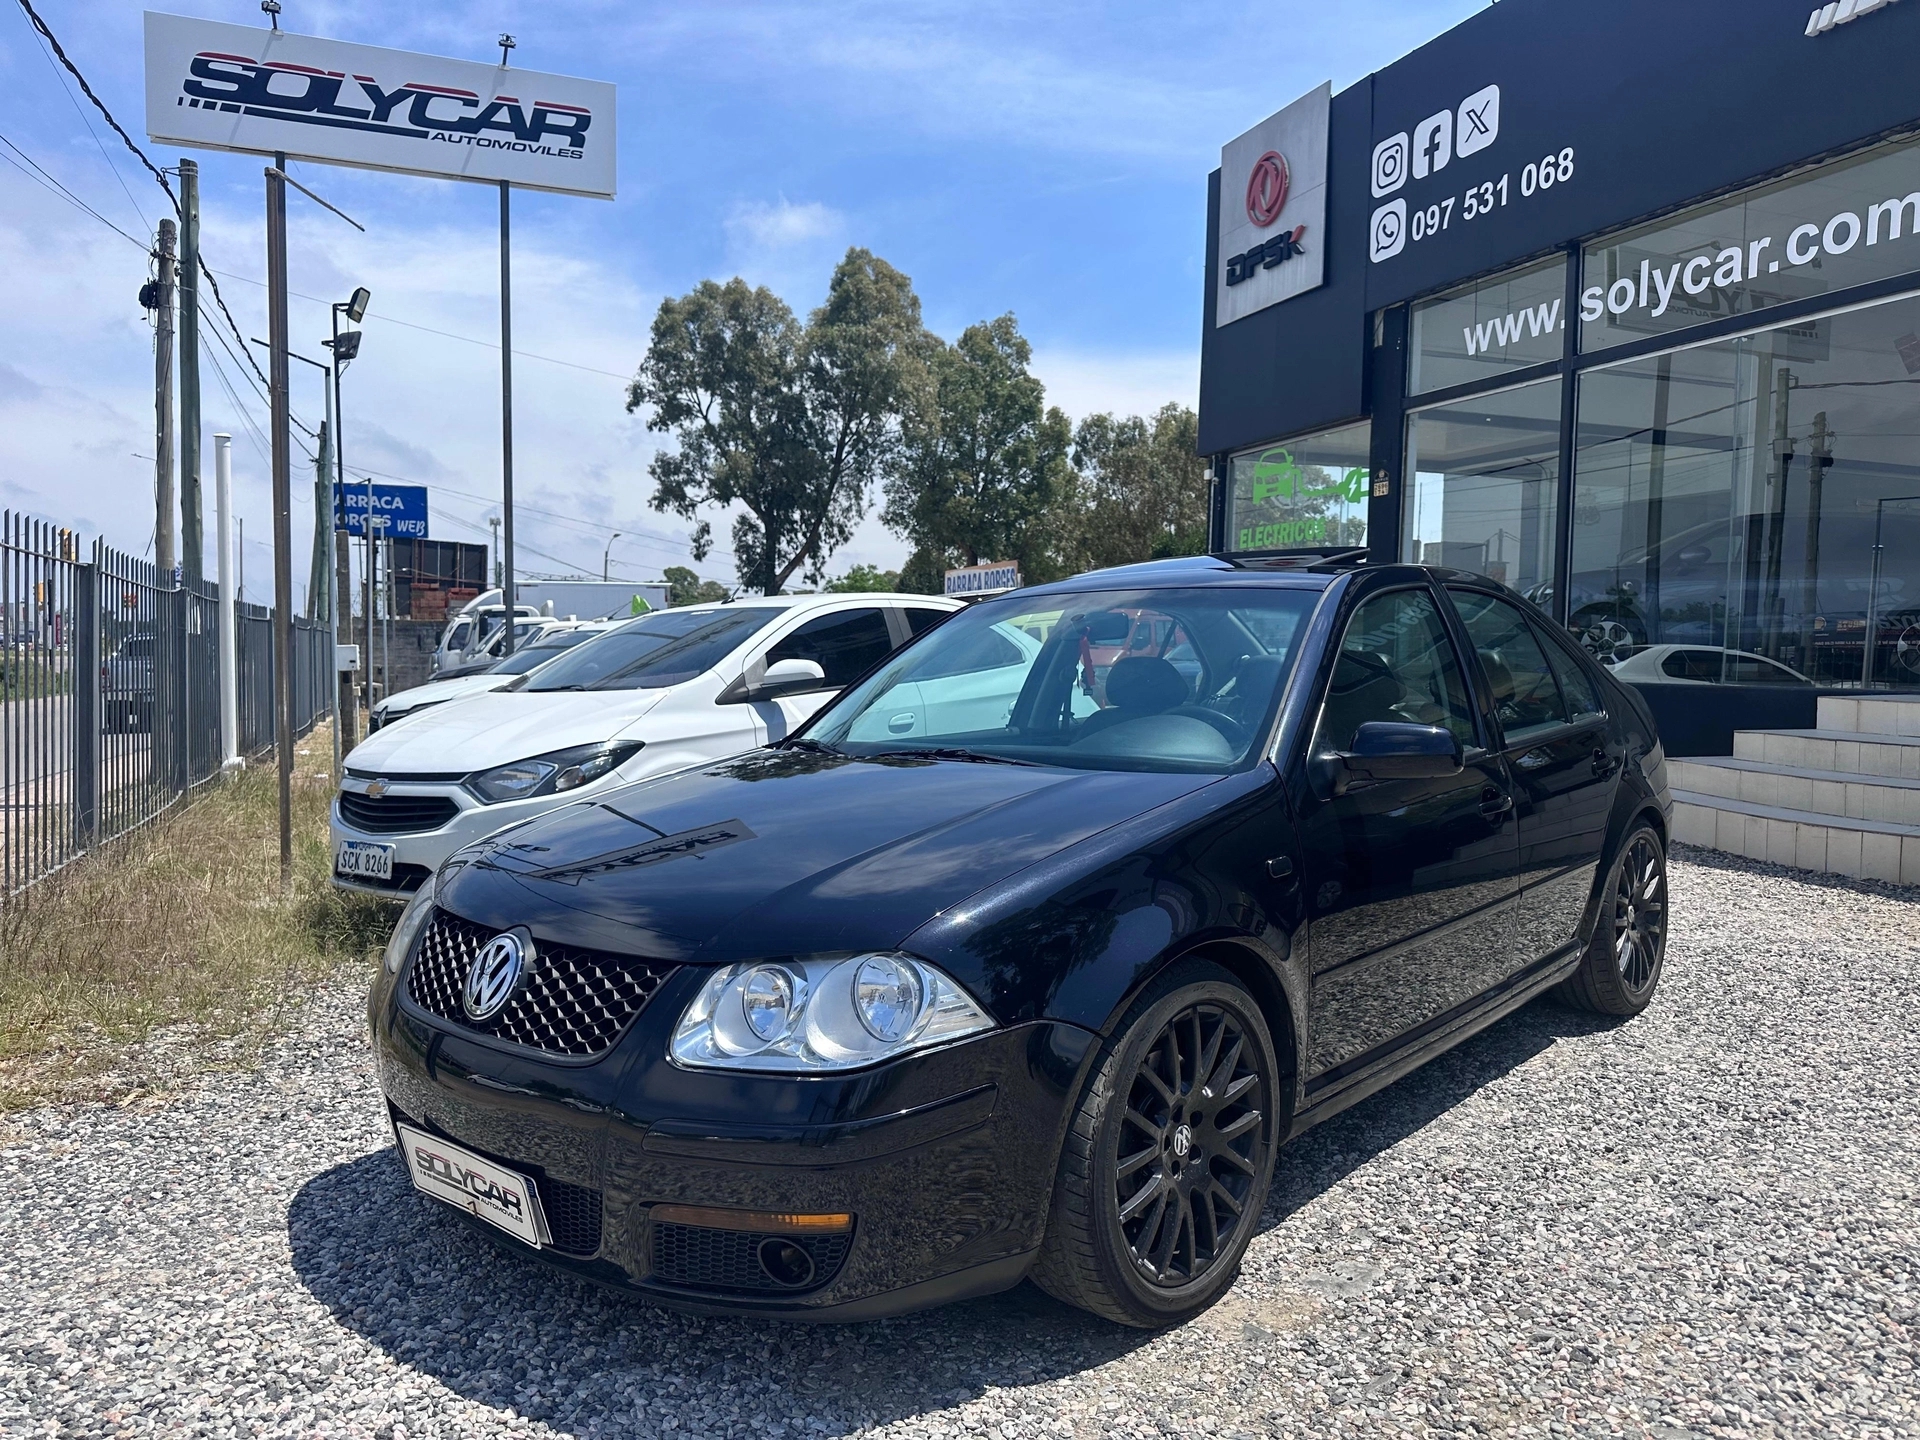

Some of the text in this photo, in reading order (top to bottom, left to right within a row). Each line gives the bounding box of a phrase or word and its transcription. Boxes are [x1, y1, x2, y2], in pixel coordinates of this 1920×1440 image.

[183, 51, 592, 149] SOLYCAR
[430, 131, 584, 160] AUTOMOVILES
[1411, 146, 1574, 241] 097 531 068
[1226, 225, 1305, 286] DFSK
[334, 494, 404, 510] ARRACA
[946, 567, 1016, 594] BARRACA BORGES
[341, 851, 388, 873] SCK 8266
[415, 1146, 523, 1217] SOLYCAR
[480, 1198, 523, 1224] AUTOMOVILES
